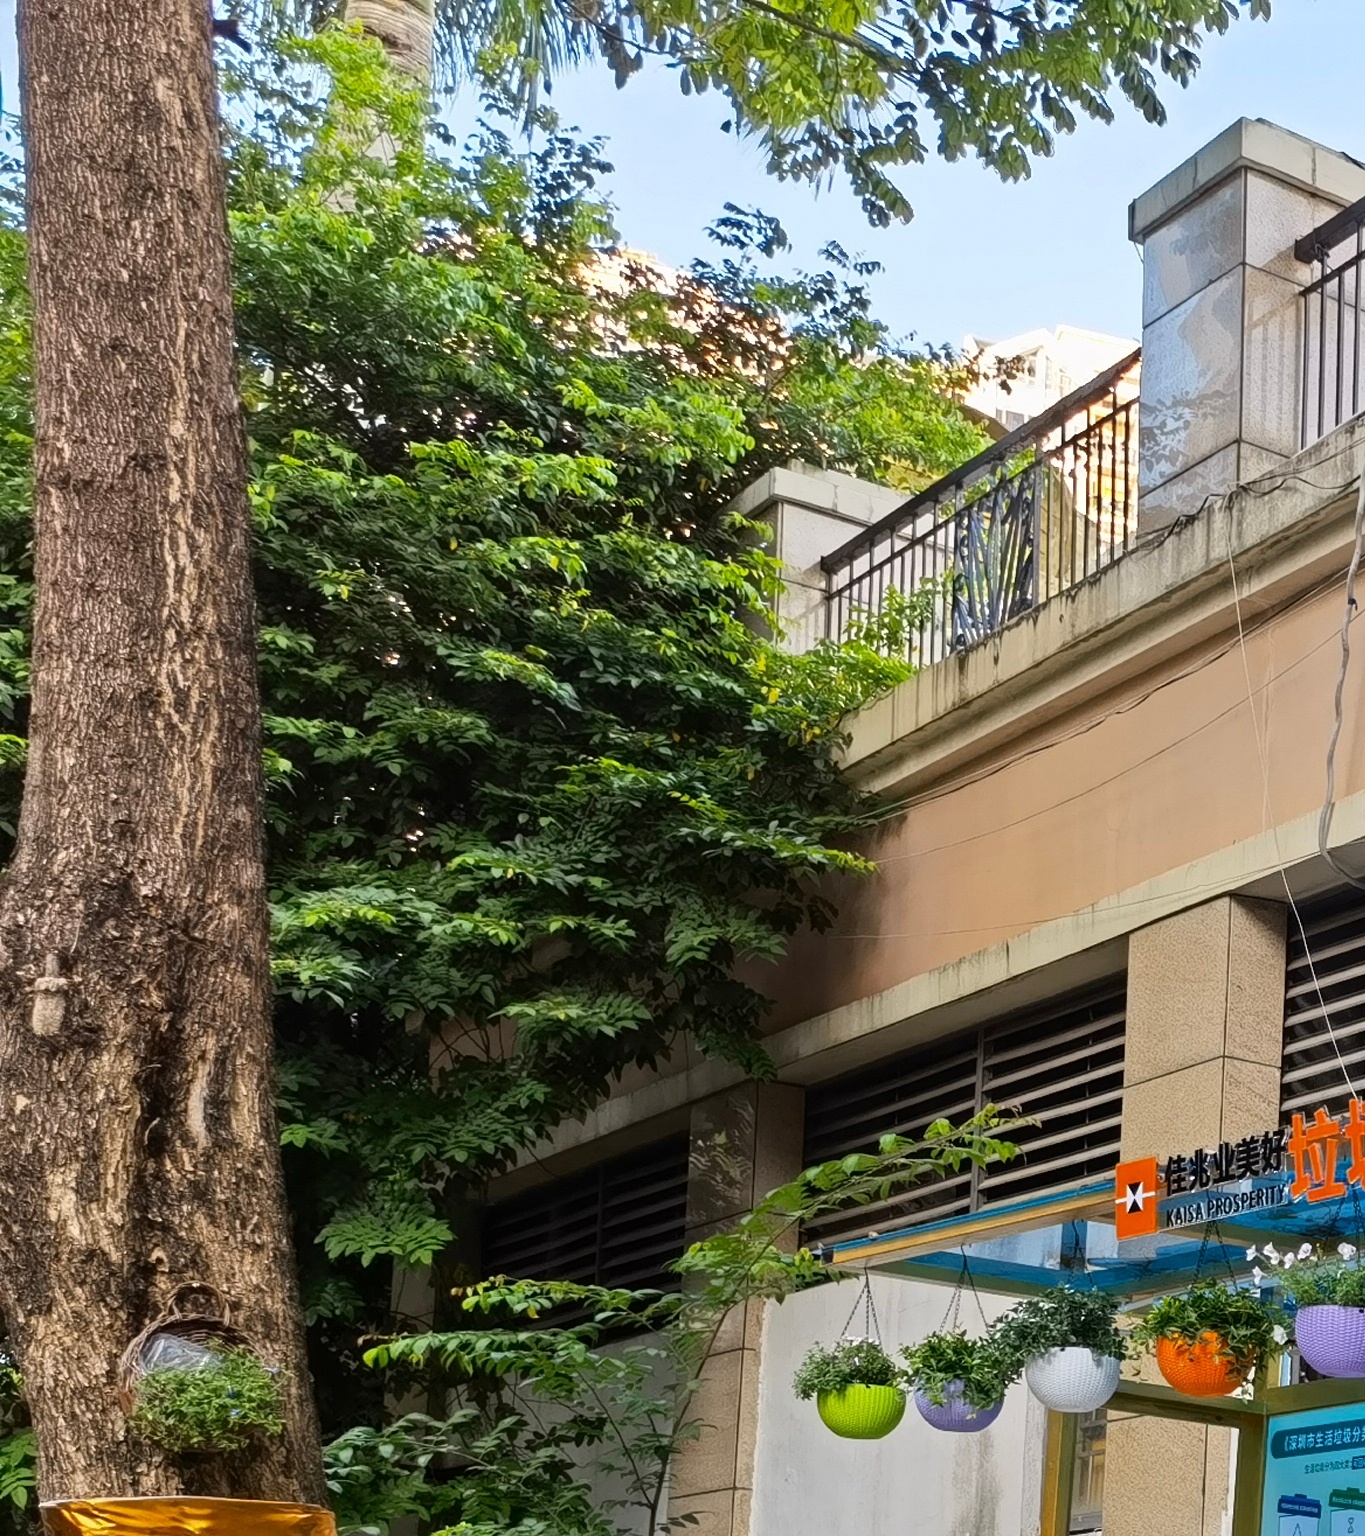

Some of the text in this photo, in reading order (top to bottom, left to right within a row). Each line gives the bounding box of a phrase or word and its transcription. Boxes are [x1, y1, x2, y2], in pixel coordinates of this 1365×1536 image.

[1165, 1129, 1289, 1196] 佳兆业美好
[1166, 1184, 1286, 1228] KAISA PROSPERITY
